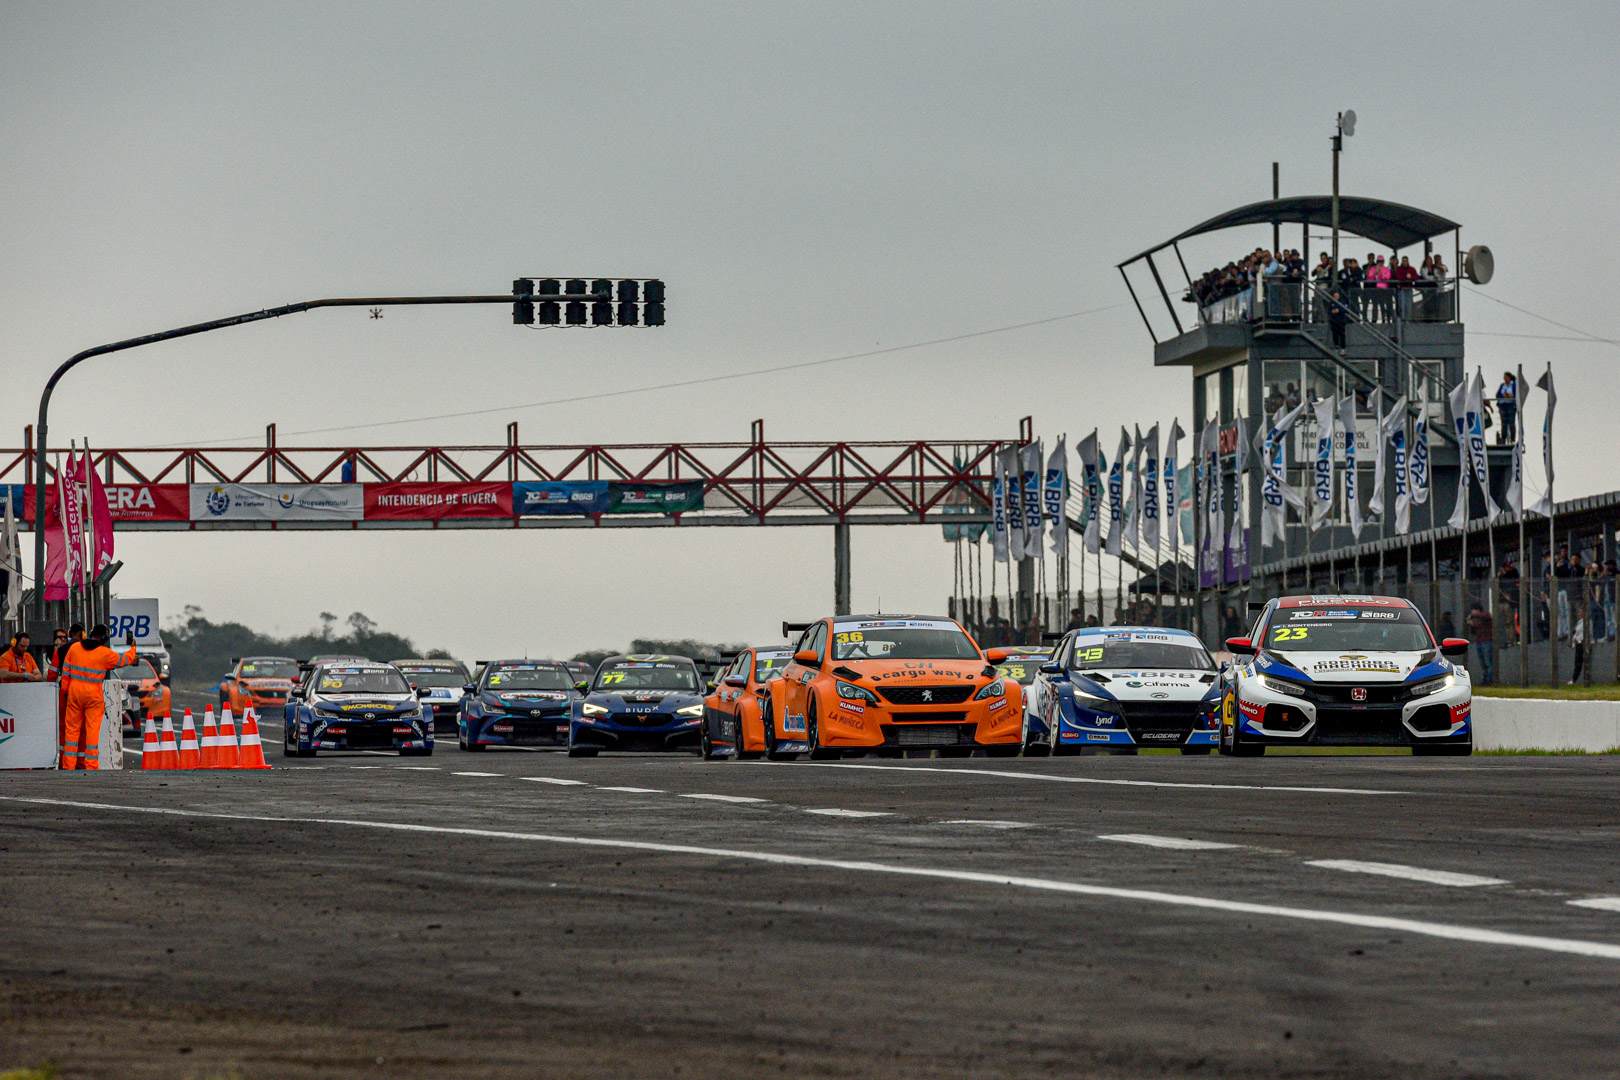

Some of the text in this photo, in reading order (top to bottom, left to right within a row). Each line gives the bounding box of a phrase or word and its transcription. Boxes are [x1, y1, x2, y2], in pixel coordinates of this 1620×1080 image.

[1334, 431, 1366, 439] COOL
[1334, 442, 1370, 450] COOLE
[1315, 461, 1331, 501] BRB
[378, 492, 498, 506] INTENDENCIA DE RIVERA
[1009, 494, 1023, 529] BRB
[1024, 491, 1040, 527] BRB
[1373, 612, 1395, 620] BRB
[110, 615, 151, 638] BRB
[836, 632, 864, 644] 36
[1274, 627, 1308, 642] 23
[1077, 648, 1104, 660] 43
[882, 670, 962, 679] cargo way
[997, 668, 1026, 679] 28
[323, 680, 343, 689] 70
[491, 676, 502, 685] 2
[603, 674, 625, 685] 77
[840, 702, 865, 713] KUMHO
[828, 711, 838, 721] LA
[1095, 715, 1113, 727] Lynd
